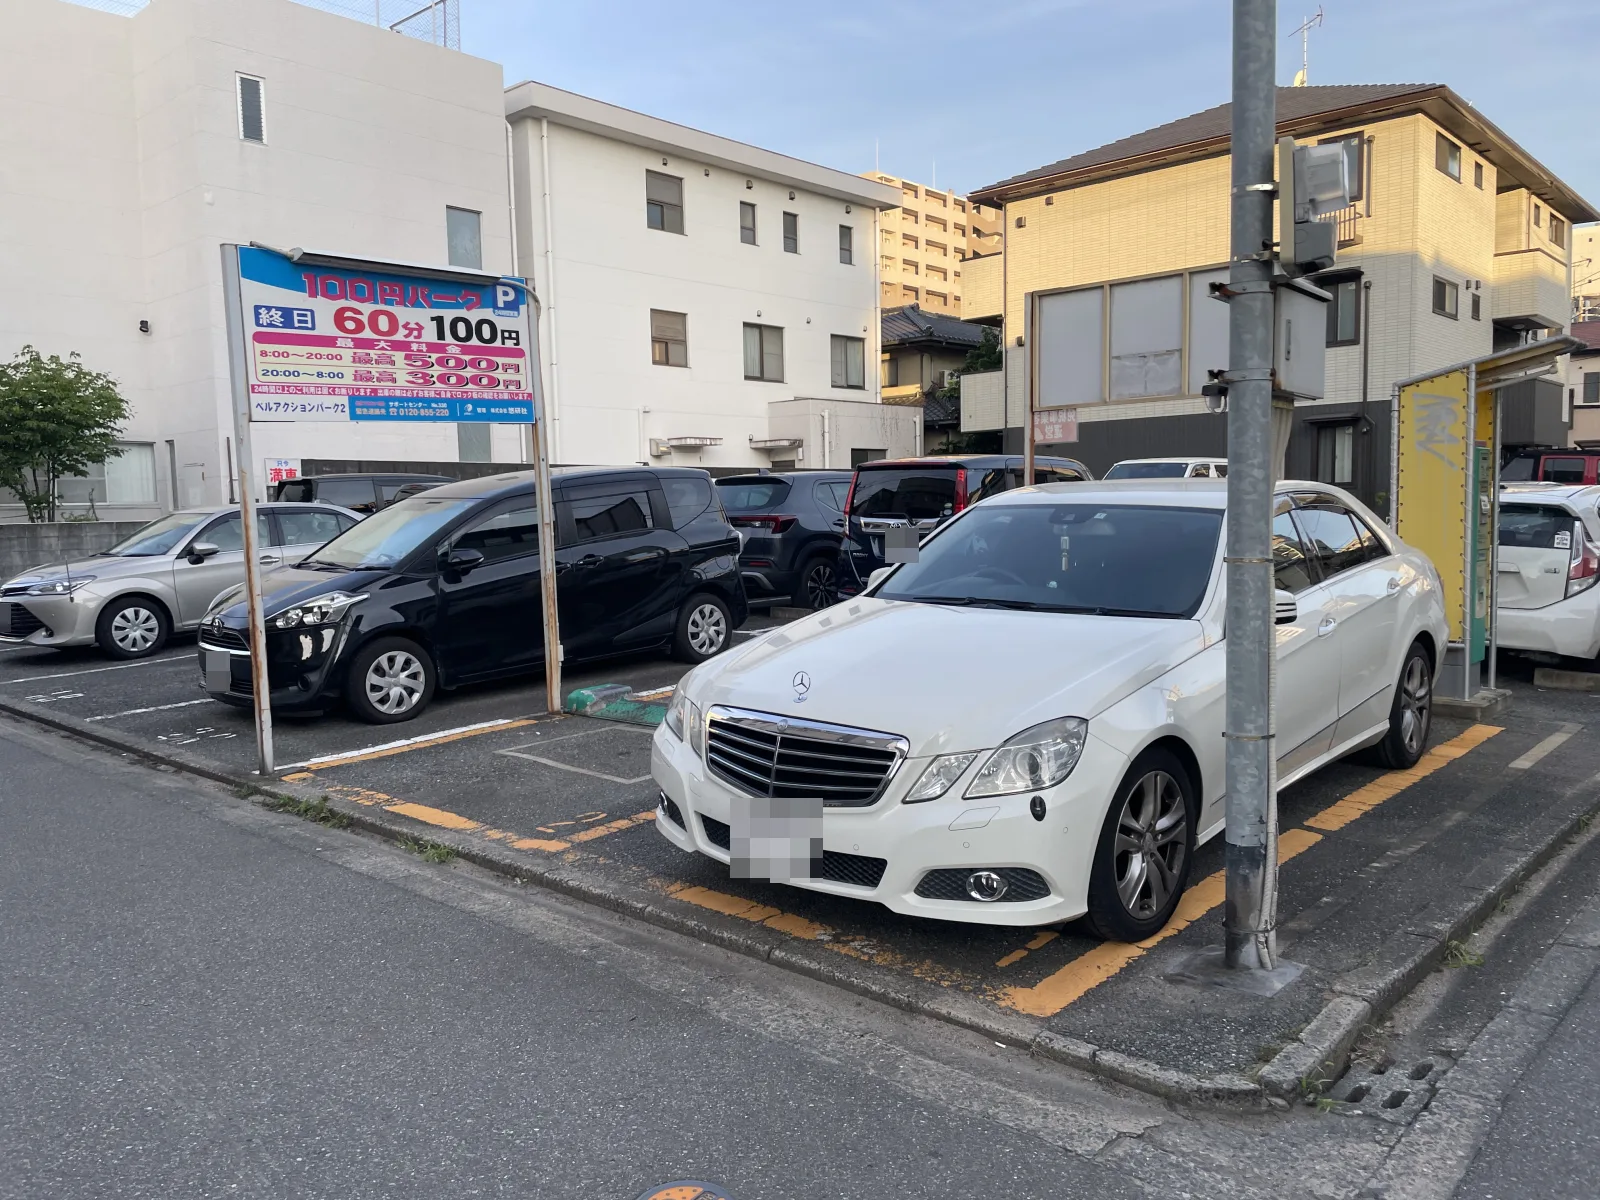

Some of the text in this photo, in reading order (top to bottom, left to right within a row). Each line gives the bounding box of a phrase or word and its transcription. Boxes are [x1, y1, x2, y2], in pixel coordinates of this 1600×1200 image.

[302, 272, 482, 312] 100円パーク
[496, 285, 516, 308] P
[258, 307, 313, 328] 終日
[333, 306, 521, 347] 60分 100円
[335, 337, 462, 354] 最大料金
[351, 352, 396, 367] 最高
[403, 353, 520, 373] 500円
[352, 370, 397, 384] 最高
[404, 371, 521, 389] 300円
[269, 467, 298, 482] 満車
